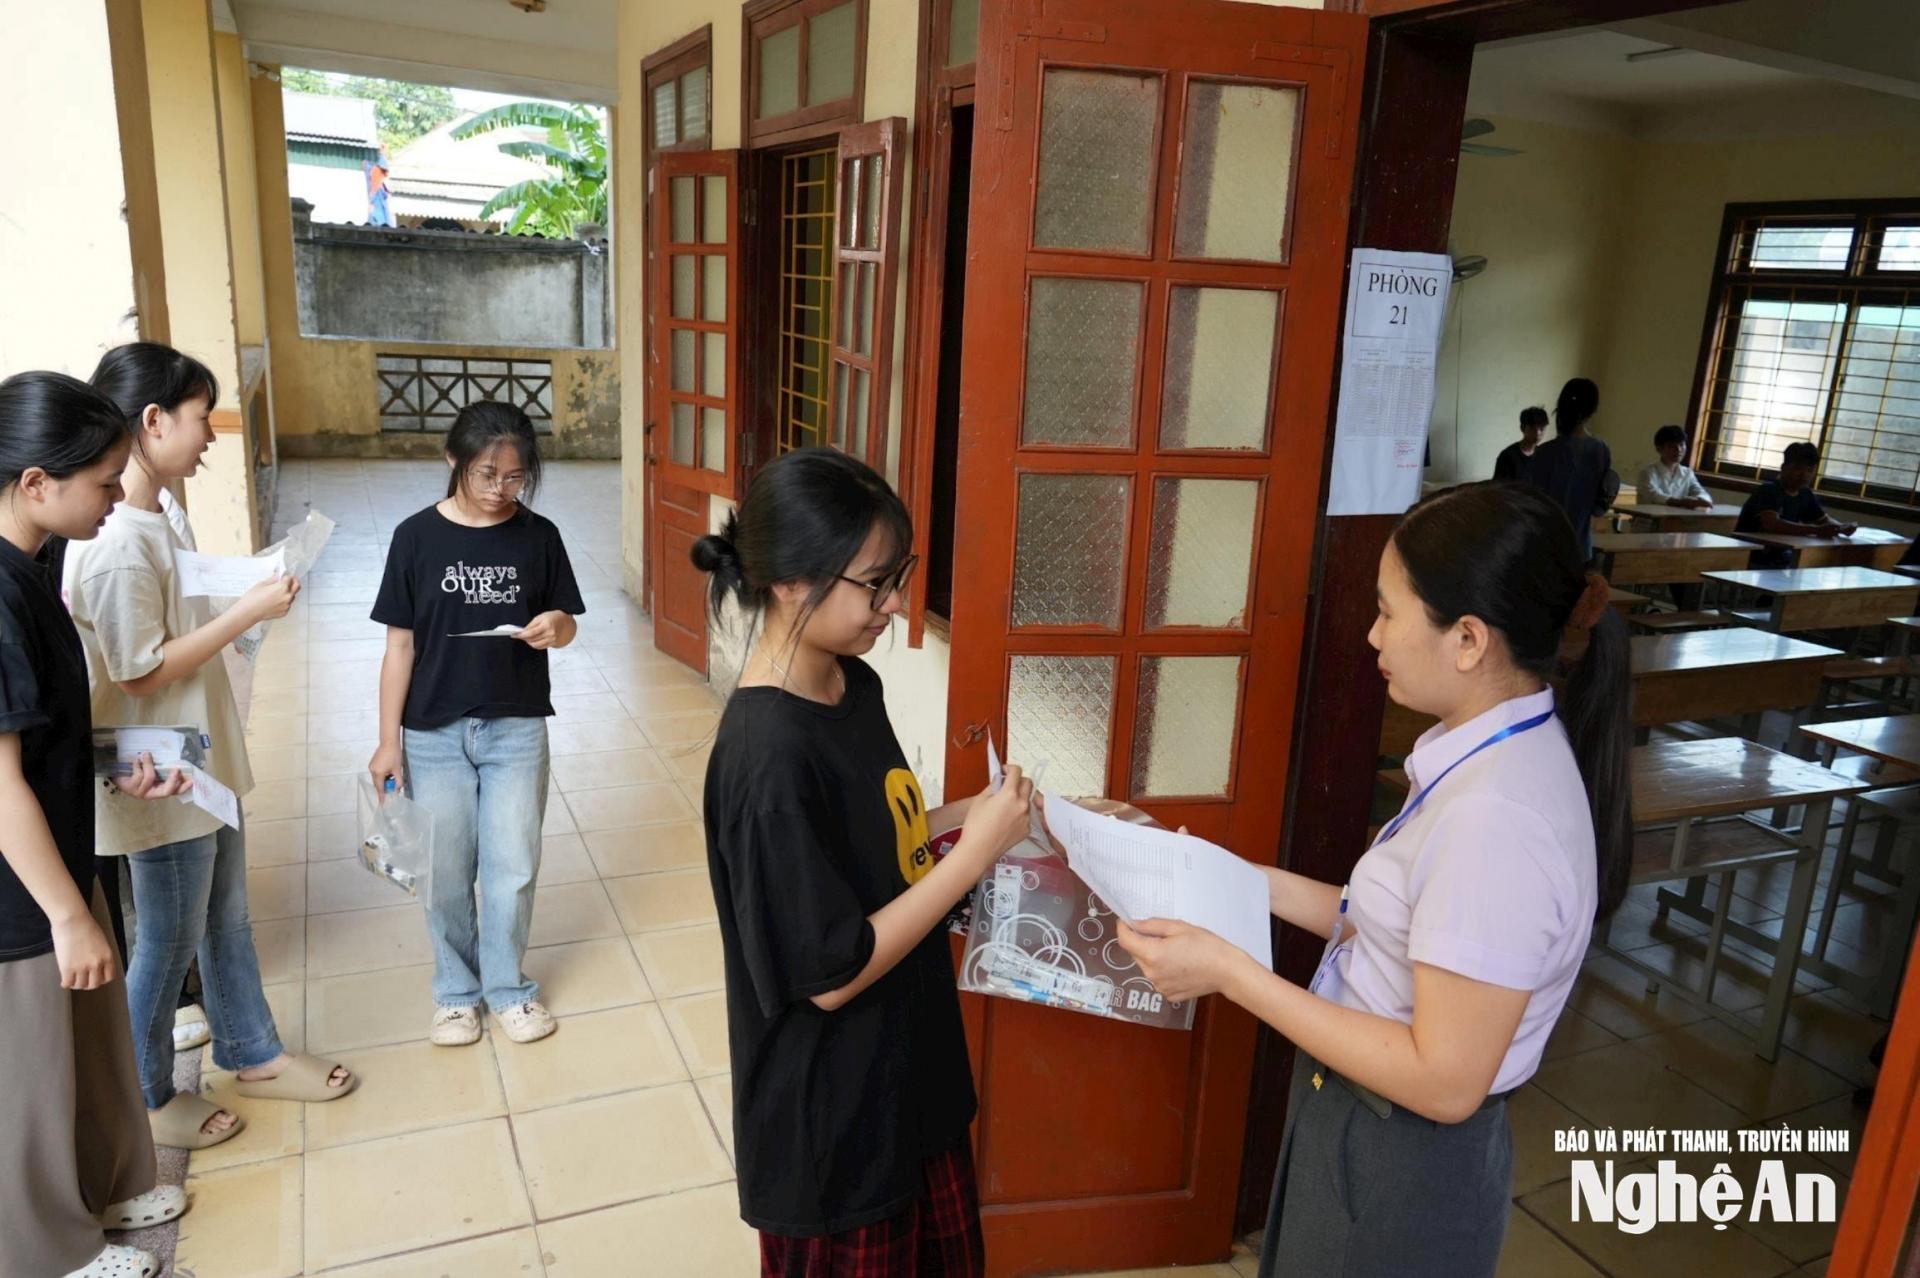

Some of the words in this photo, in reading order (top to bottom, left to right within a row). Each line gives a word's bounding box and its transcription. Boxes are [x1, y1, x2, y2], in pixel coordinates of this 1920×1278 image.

[1368, 269, 1438, 297] PHÒNG
[1389, 305, 1407, 325] 21
[445, 560, 517, 584] always
[441, 577, 493, 593] OUR
[1126, 989, 1163, 1013] BAG
